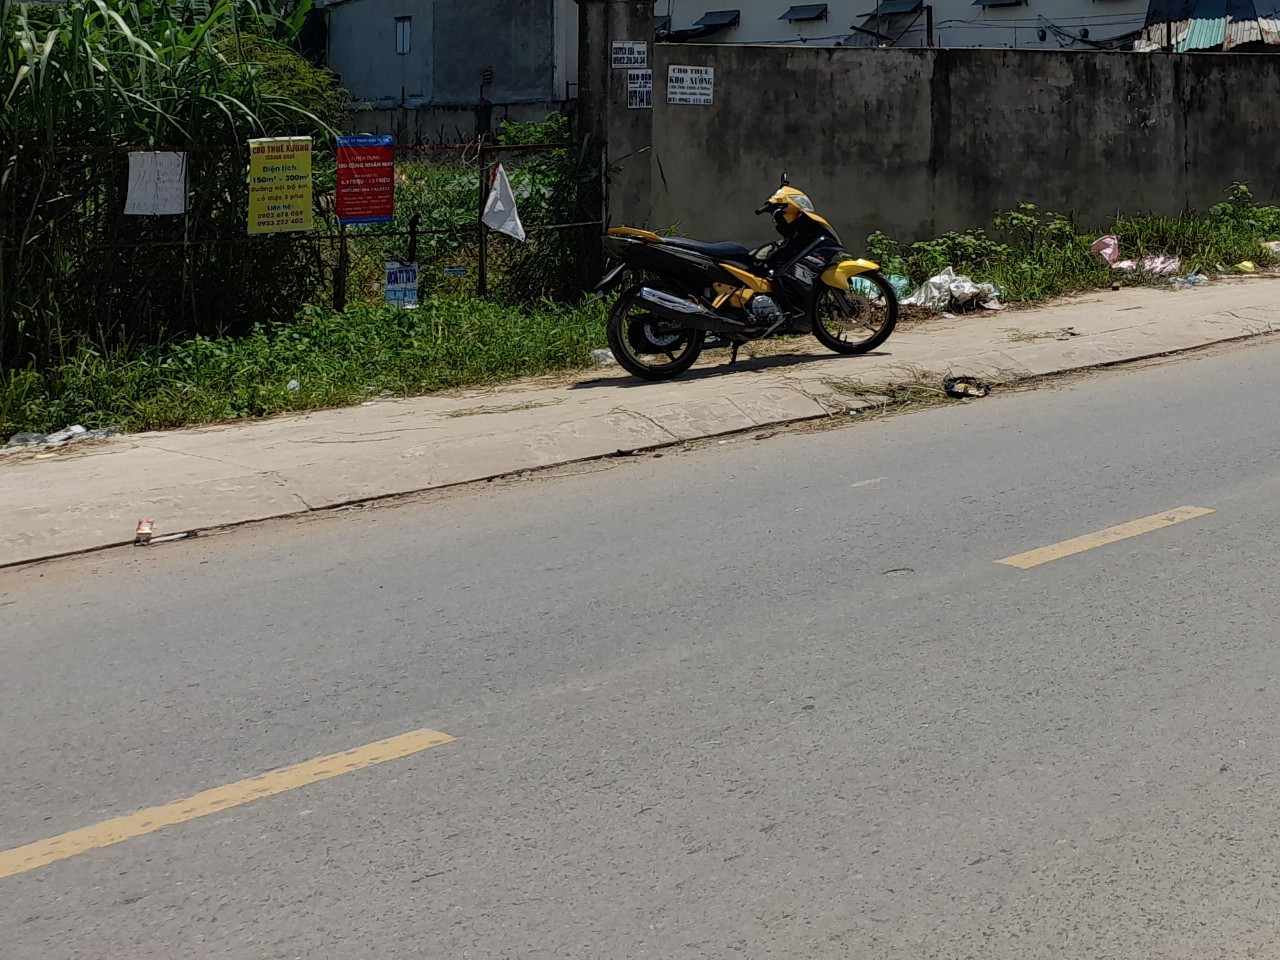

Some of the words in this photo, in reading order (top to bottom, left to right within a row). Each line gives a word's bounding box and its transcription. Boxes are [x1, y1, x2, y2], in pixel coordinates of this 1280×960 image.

[267, 144, 285, 154] THUÊ
[282, 164, 299, 172] tích:
[253, 176, 277, 184] 150m²
